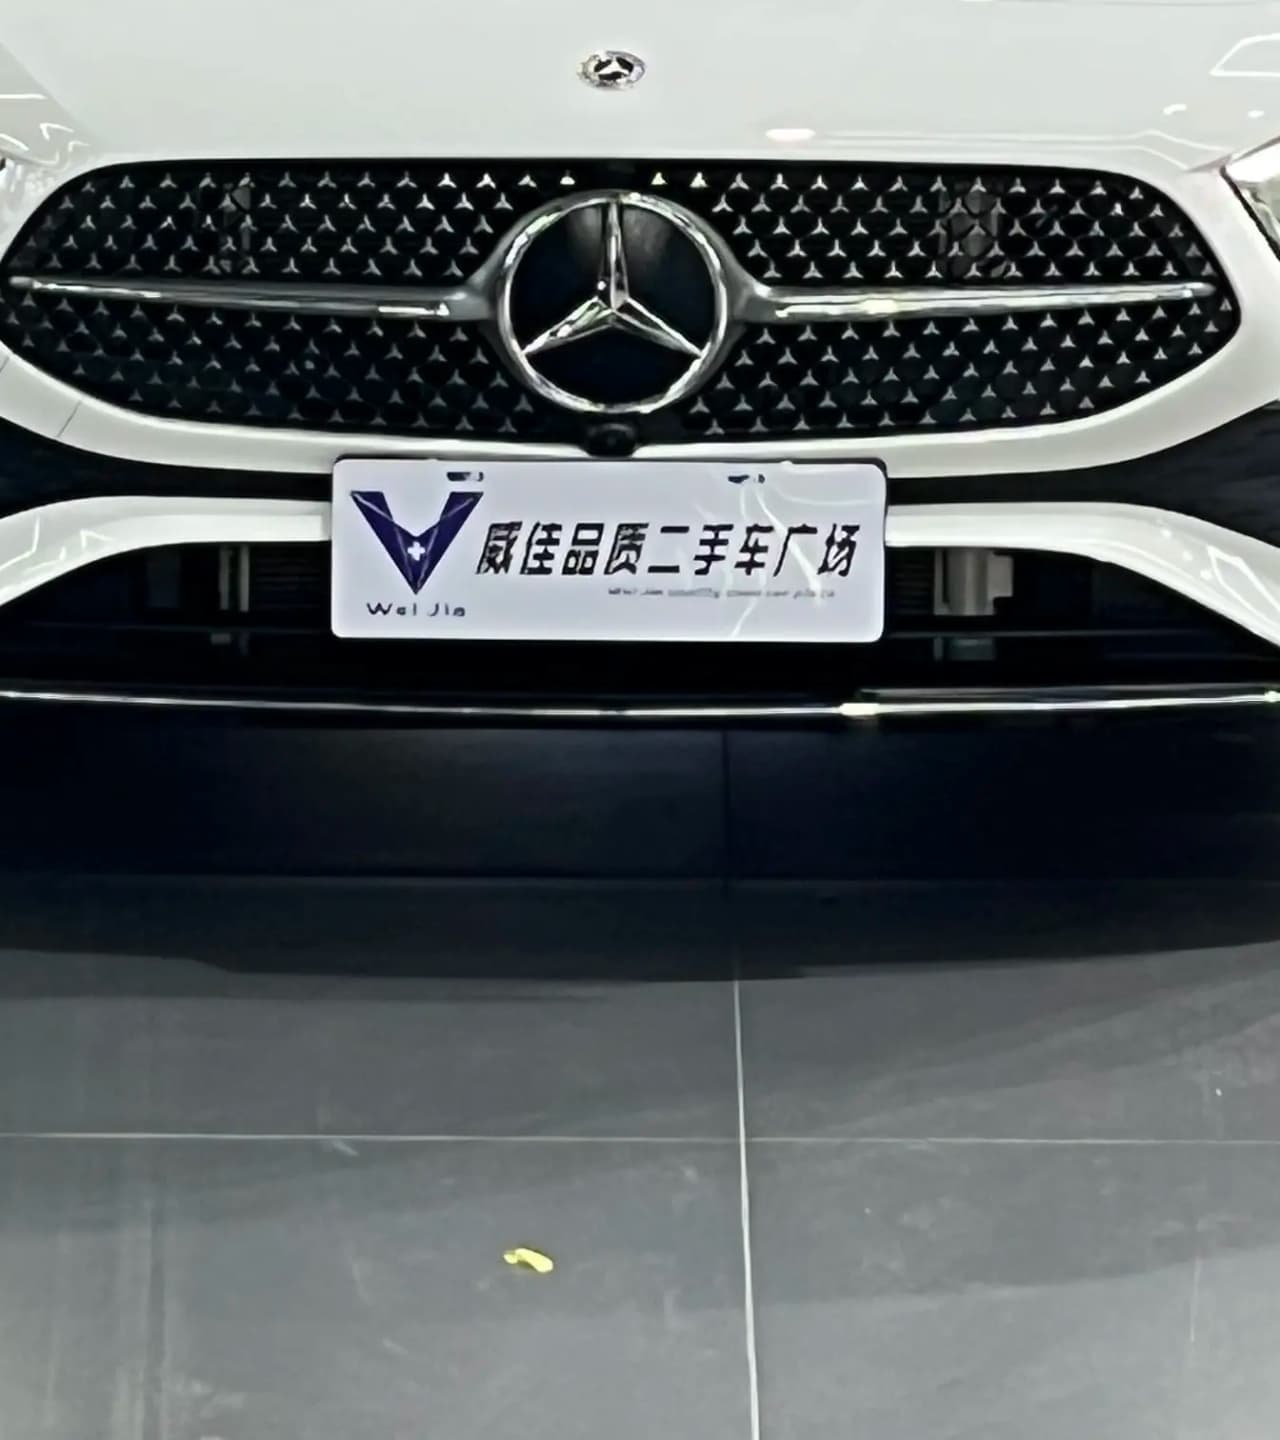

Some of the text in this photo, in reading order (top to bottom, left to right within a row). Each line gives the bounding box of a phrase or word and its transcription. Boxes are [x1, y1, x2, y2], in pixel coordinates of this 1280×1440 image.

[475, 521, 861, 577] 威佳品质二手车广场
